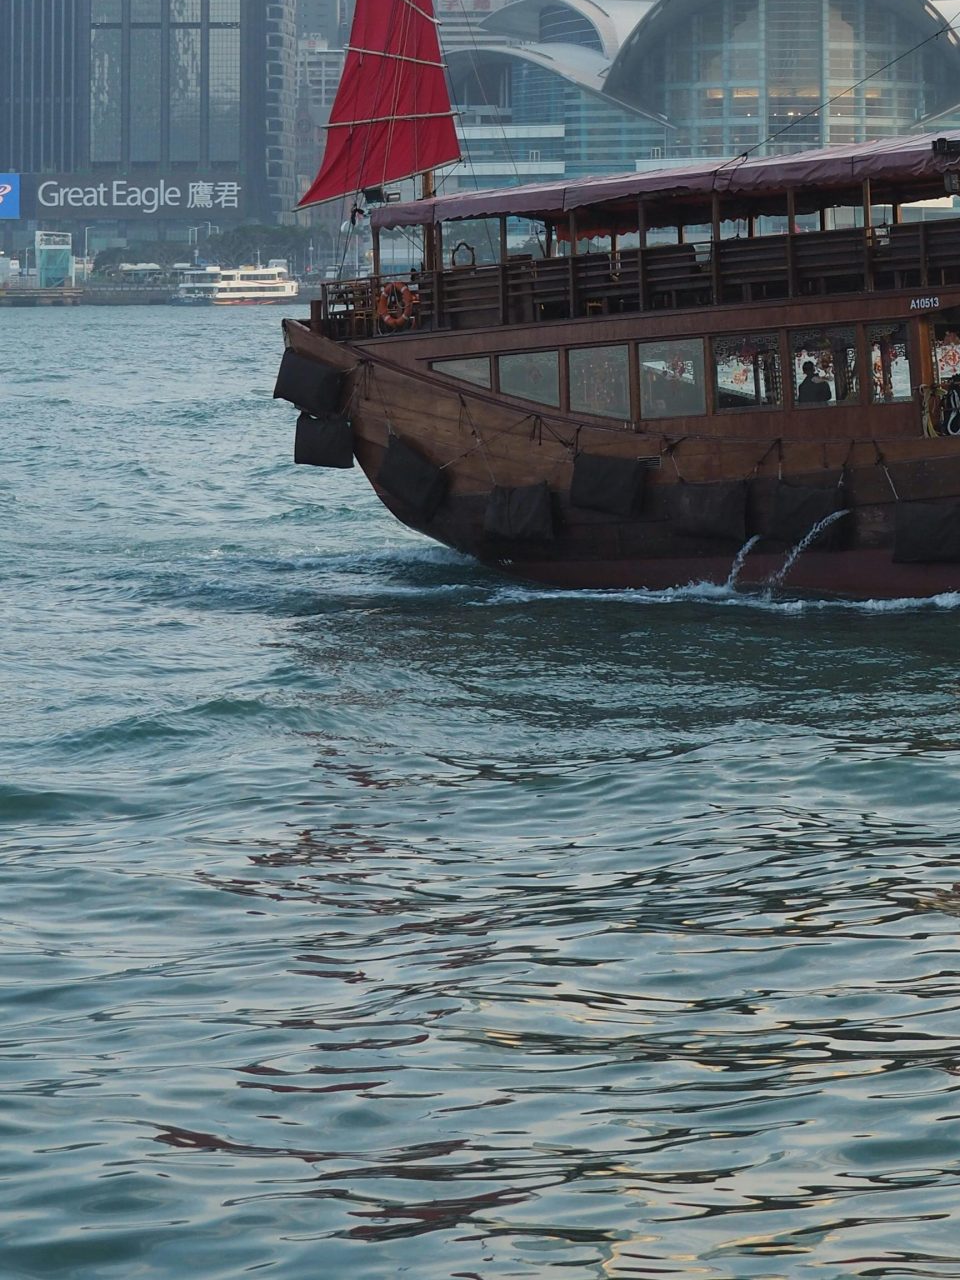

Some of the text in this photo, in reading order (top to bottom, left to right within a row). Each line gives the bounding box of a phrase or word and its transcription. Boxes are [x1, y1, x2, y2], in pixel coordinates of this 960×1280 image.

[37, 181, 108, 206] Great
[112, 179, 181, 213] Eagle
[186, 180, 242, 209] 鷹君
[910, 297, 939, 309] A10513
